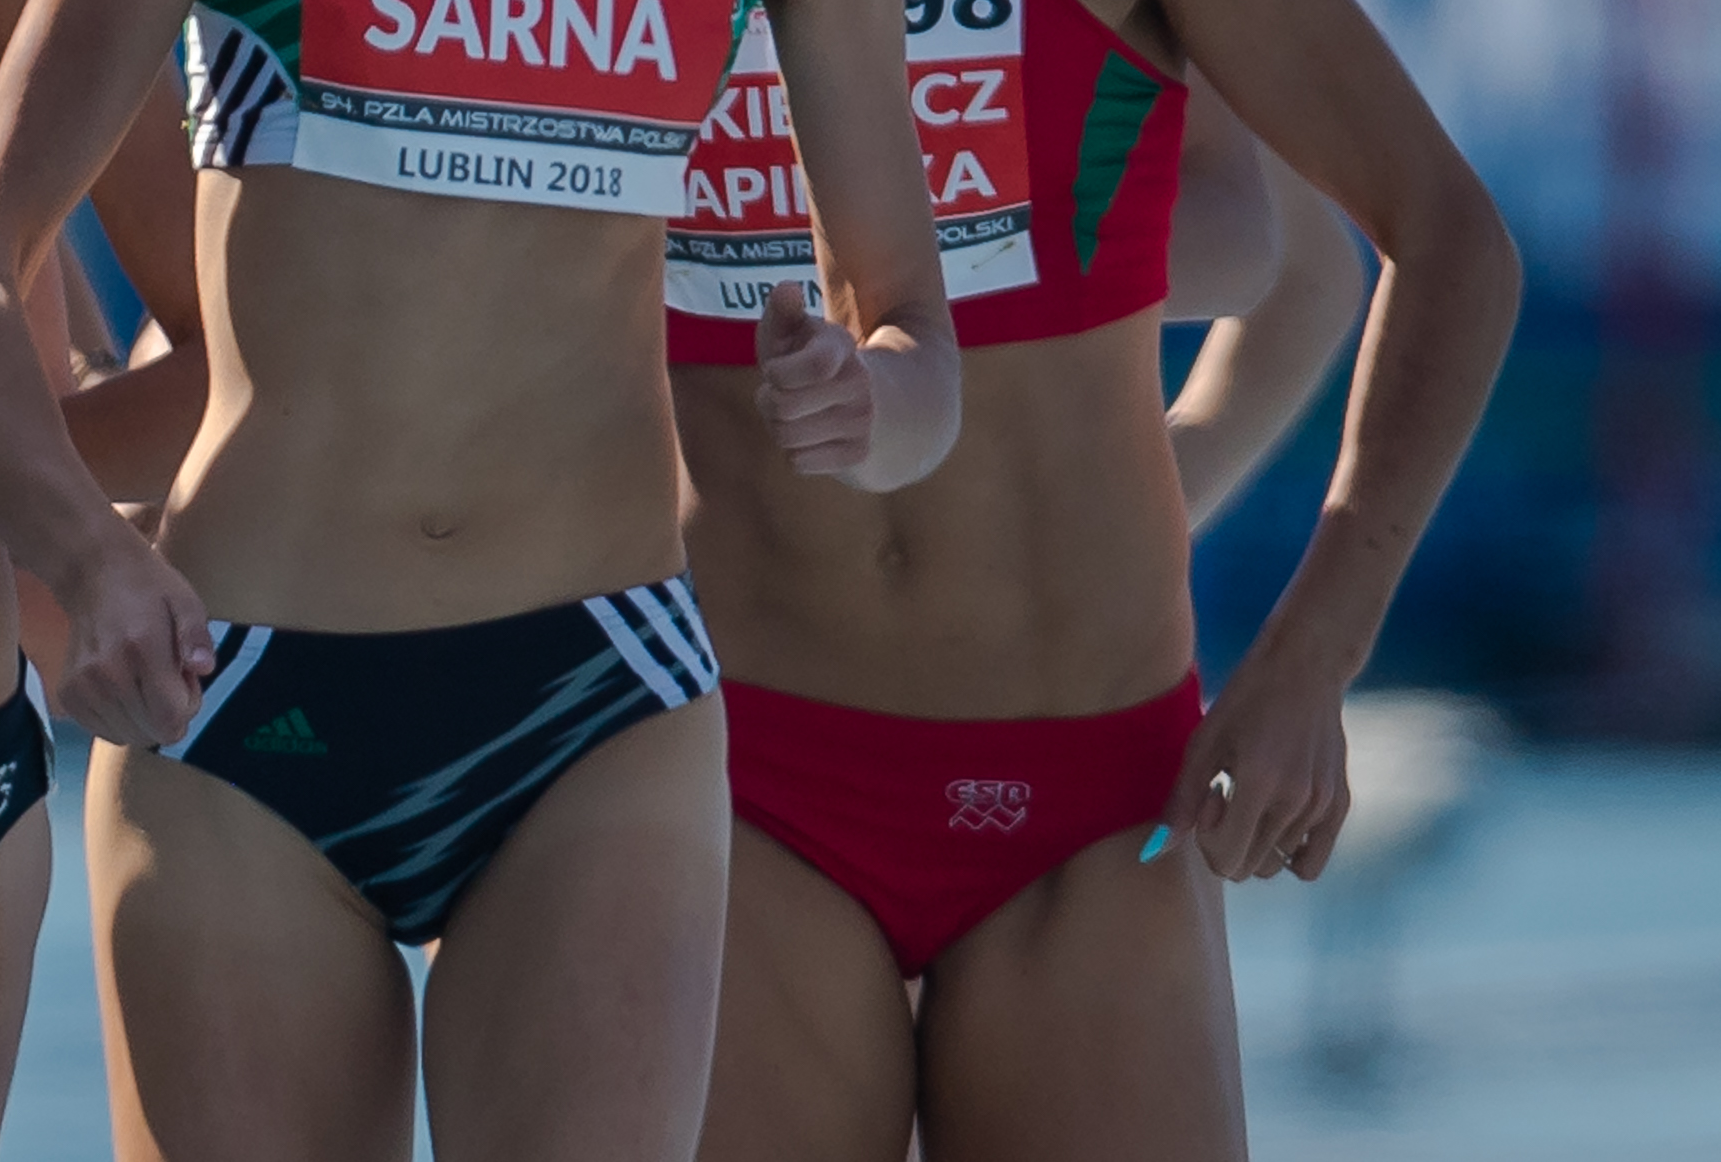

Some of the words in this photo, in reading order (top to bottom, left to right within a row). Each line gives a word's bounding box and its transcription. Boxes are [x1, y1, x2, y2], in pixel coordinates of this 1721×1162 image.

[364, 100, 434, 125] PZLA
[440, 107, 624, 144] MISTRZOSTWA
[398, 146, 533, 189] LUBLIN
[547, 161, 622, 198] 2018
